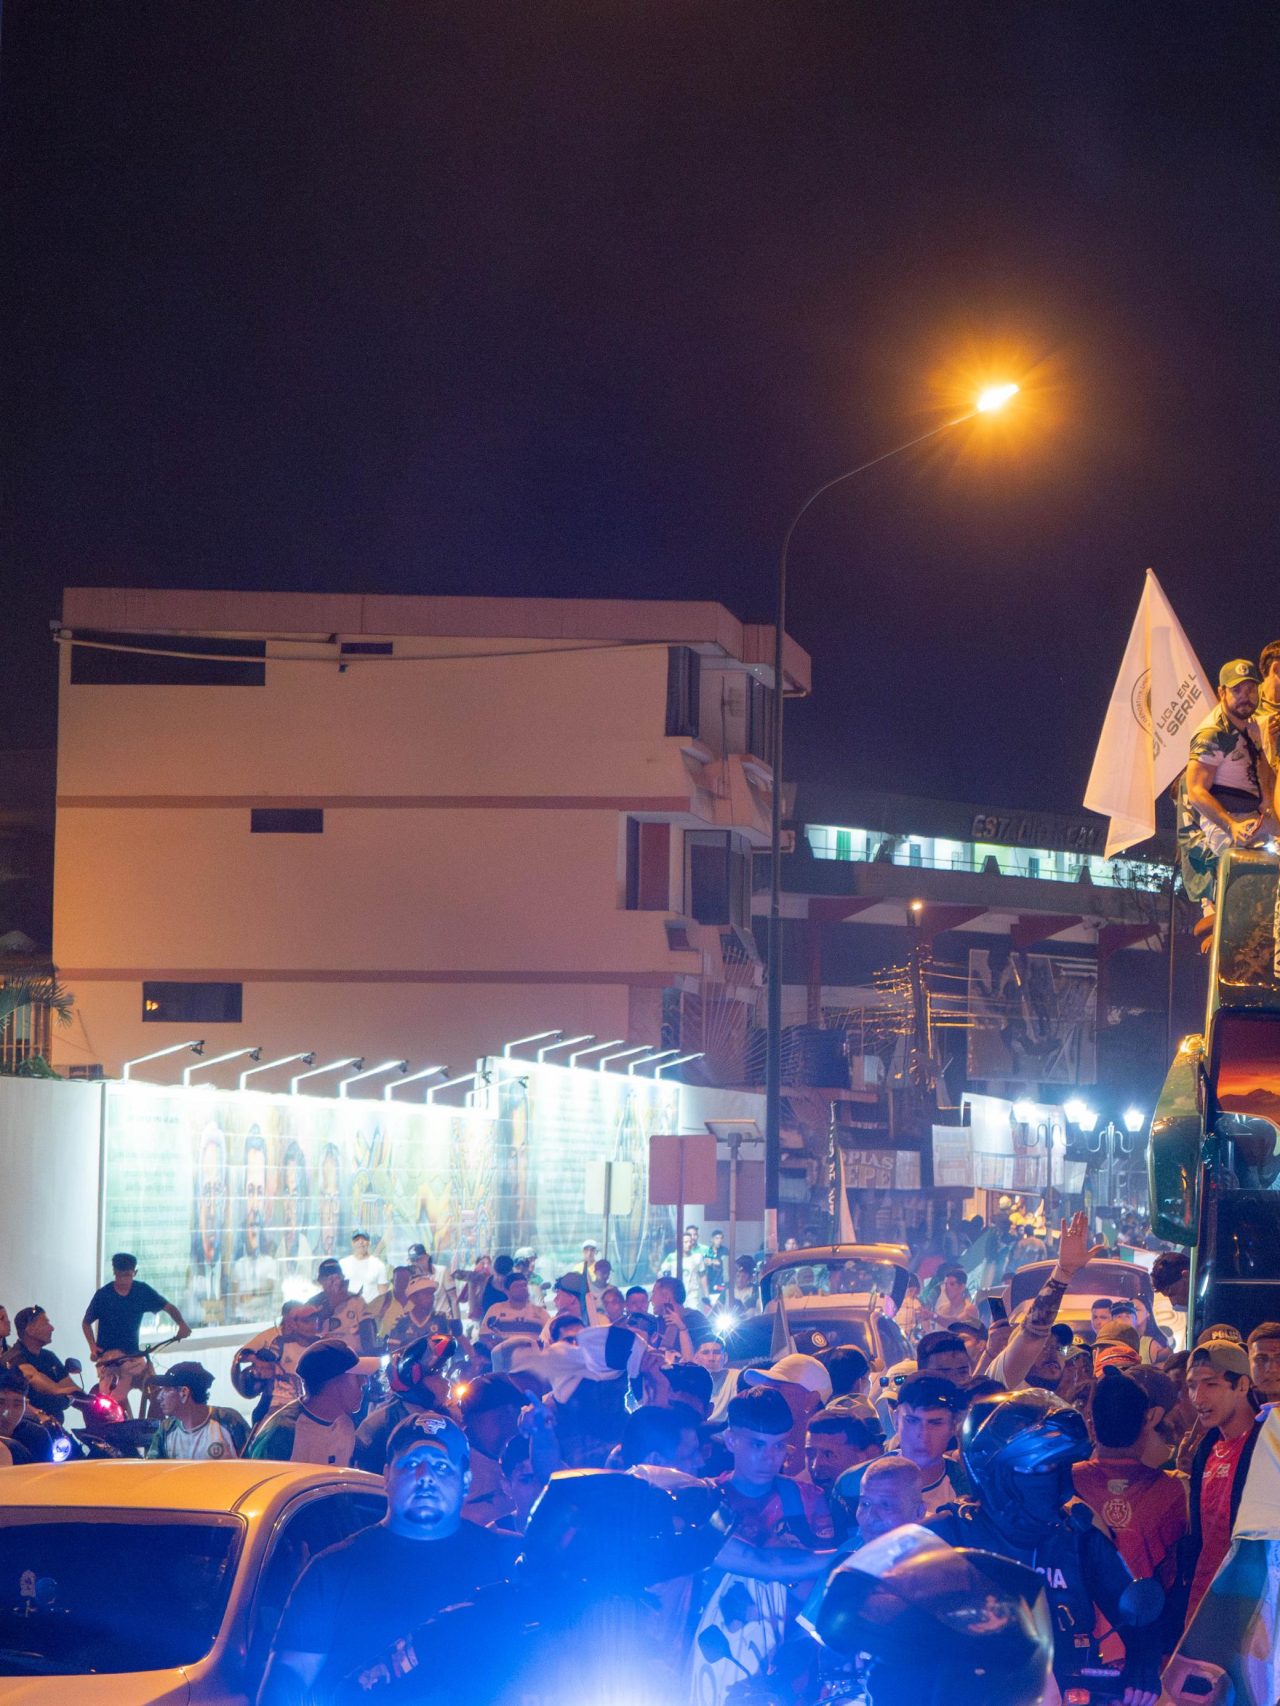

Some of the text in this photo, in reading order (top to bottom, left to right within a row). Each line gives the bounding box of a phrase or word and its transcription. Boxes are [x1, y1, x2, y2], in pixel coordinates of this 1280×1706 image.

[1156, 701, 1179, 731] LIGA
[1177, 681, 1190, 699] EN
[1166, 685, 1202, 736] SERIE
